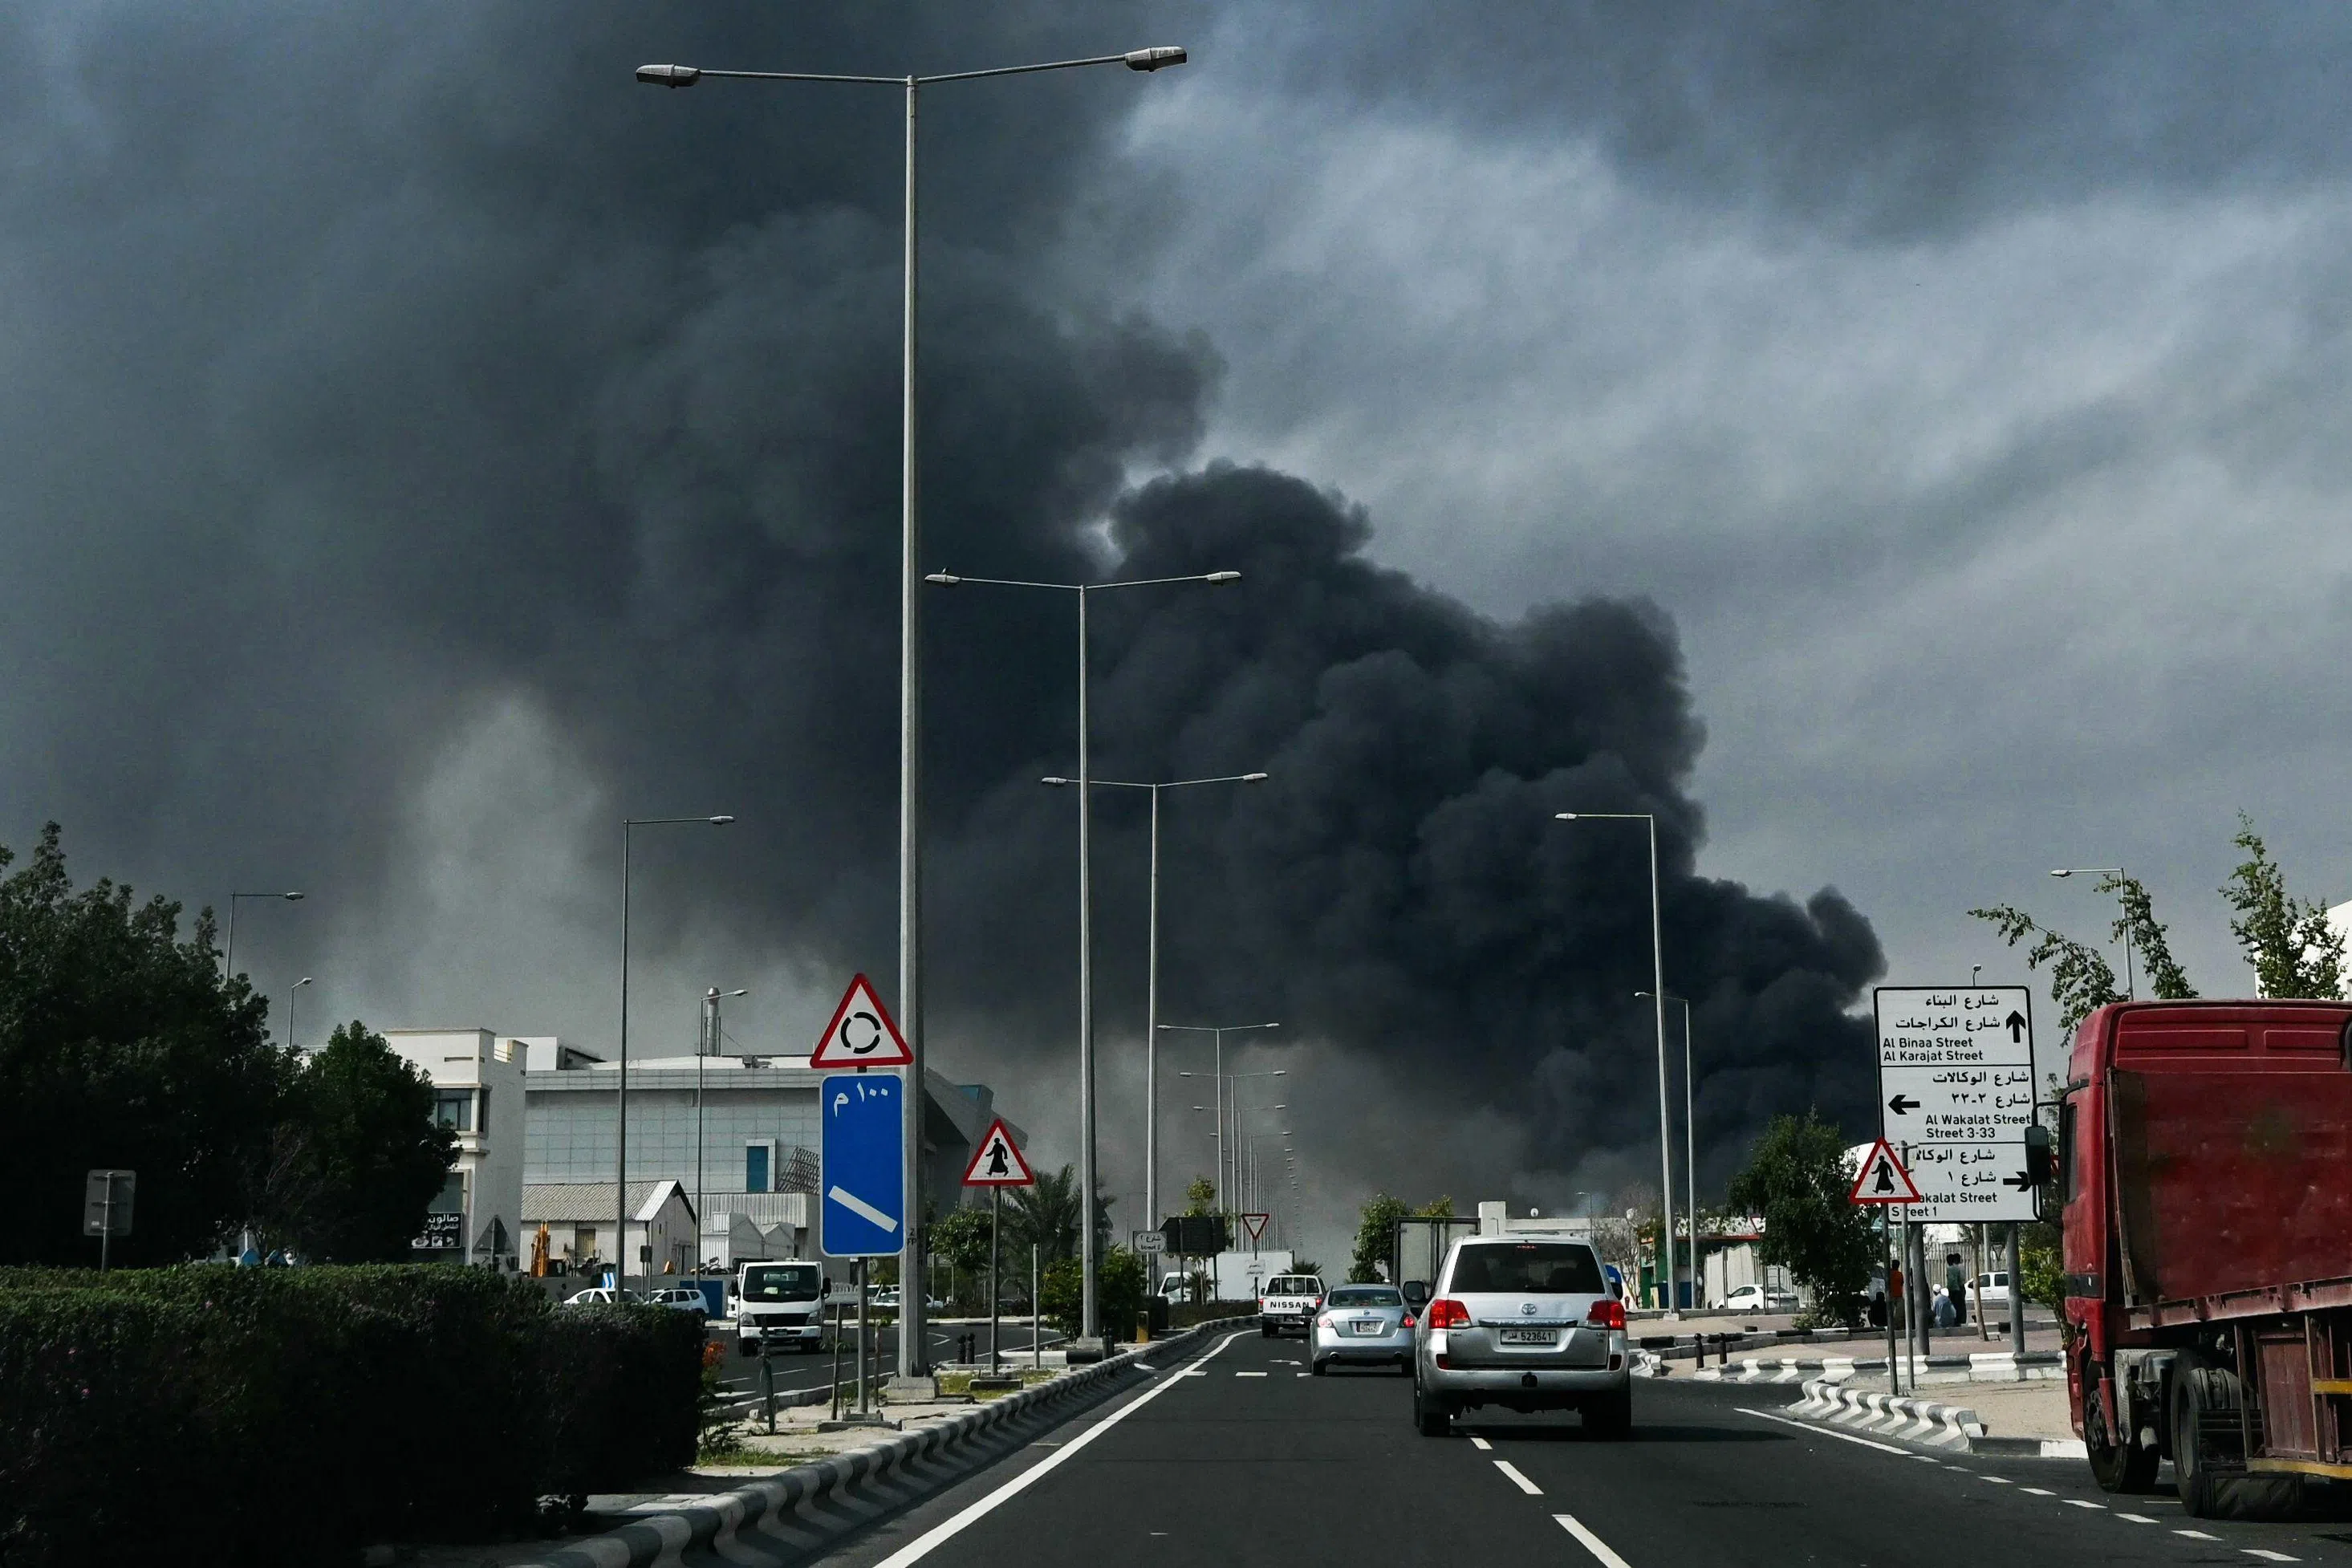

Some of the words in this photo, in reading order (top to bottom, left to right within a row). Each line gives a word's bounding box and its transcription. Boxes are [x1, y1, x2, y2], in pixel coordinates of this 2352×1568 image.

[1925, 994, 1956, 1009] البناء
[1964, 994, 1999, 1009] شارع
[1895, 1016, 1958, 1030] الكراجات
[1966, 1016, 2001, 1031] شارع
[1883, 1038, 1895, 1048] Al
[1899, 1037, 1932, 1048] Binaa
[1936, 1037, 1973, 1047] Street
[1883, 1050, 1895, 1061] Al
[1899, 1050, 1943, 1062] Karajat
[1947, 1050, 1984, 1061] Street
[1932, 1070, 1987, 1086] الوكالات
[1994, 1070, 2029, 1087] شارع
[833, 1092, 849, 1118] م
[1995, 1092, 2030, 1109] شارع
[1926, 1115, 1938, 1125] Al
[1941, 1114, 1990, 1125] Wakalat
[1993, 1114, 2031, 1124] Street
[1926, 1127, 1964, 1138] Street
[1967, 1127, 1996, 1138] 3-33
[1960, 1148, 1996, 1164] شارع
[1948, 1171, 1953, 1182] ١
[1961, 1171, 1997, 1186] شارع
[1919, 1192, 1956, 1203] akalat
[1960, 1192, 1997, 1203] Street
[1891, 1206, 1929, 1217] Sreet
[1933, 1206, 1937, 1217] 1
[1269, 1301, 1310, 1309] NISSAN
[1521, 1332, 1551, 1341] 523641
